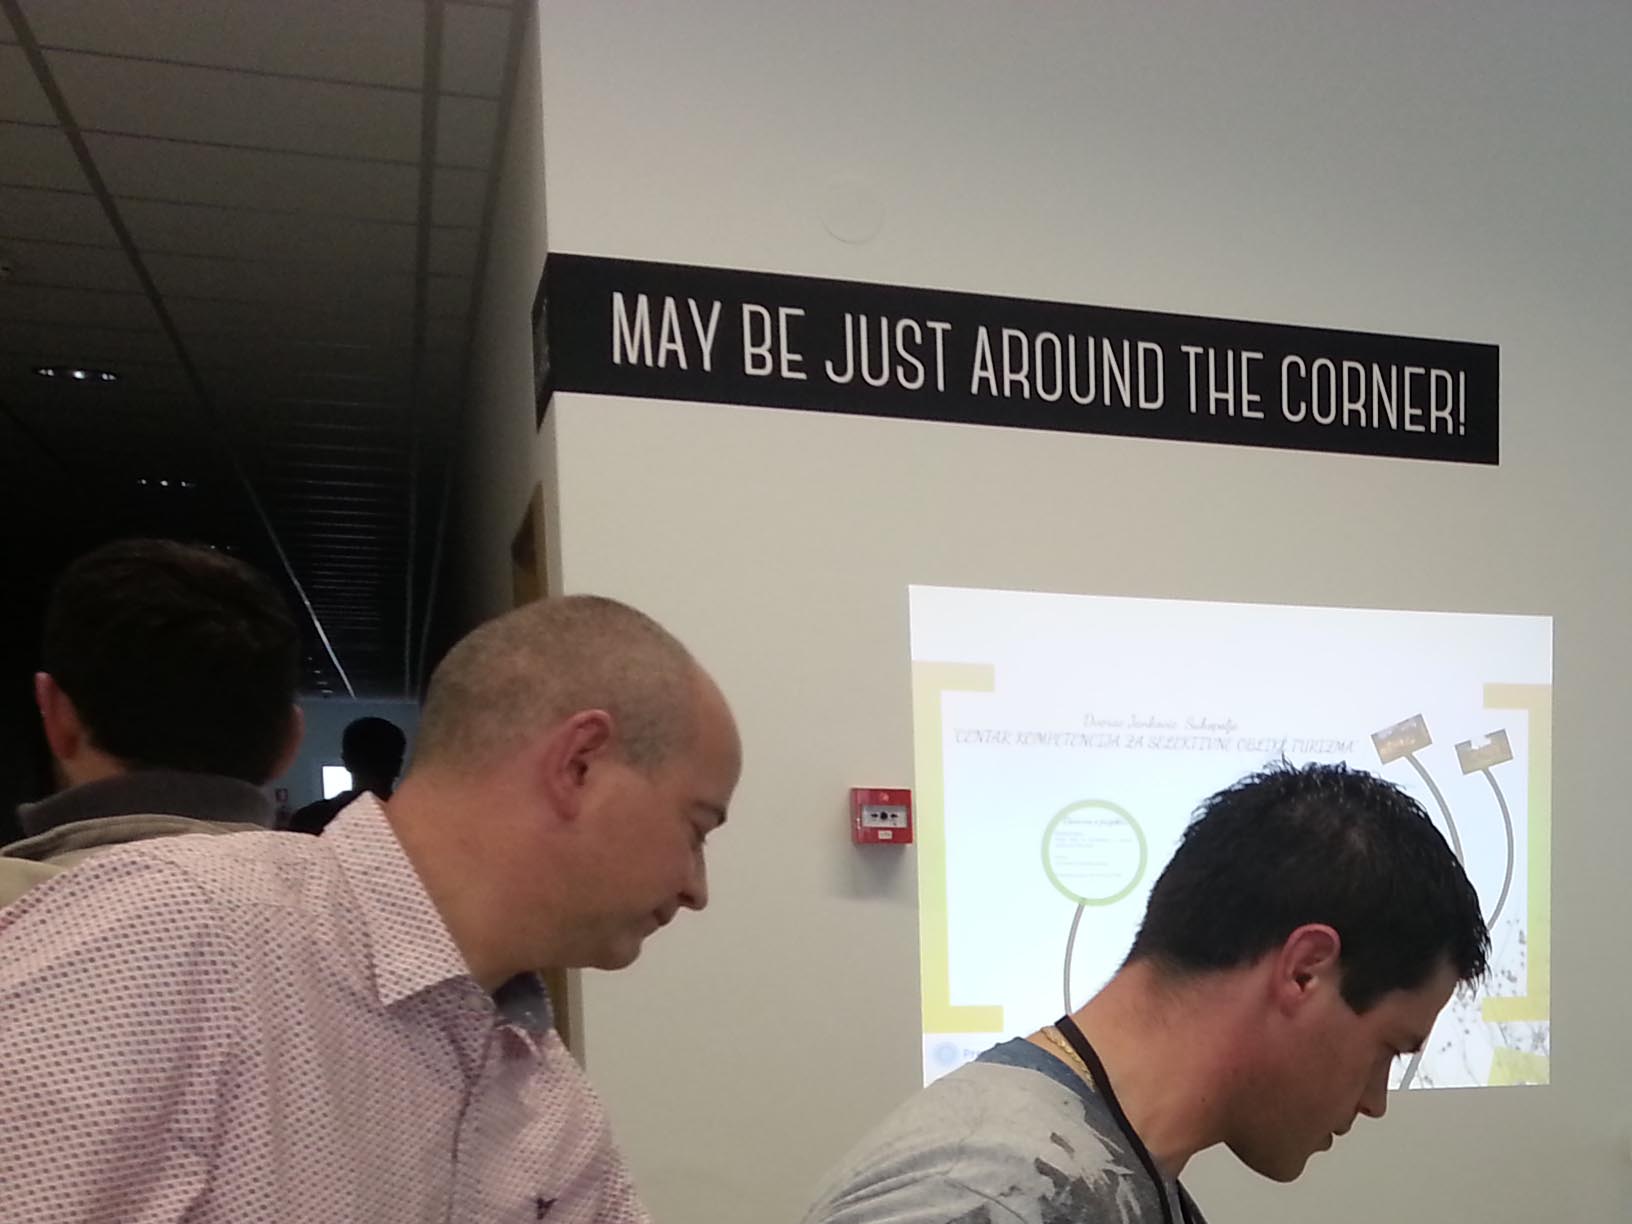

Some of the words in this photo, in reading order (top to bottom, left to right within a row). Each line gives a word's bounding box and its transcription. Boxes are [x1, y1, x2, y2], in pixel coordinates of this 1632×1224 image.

[612, 291, 722, 372] MAY
[741, 302, 807, 380] BE
[825, 312, 952, 392] JUST
[970, 325, 1164, 411] AROUND
[1180, 344, 1265, 419] THE
[1280, 354, 1467, 437] CORNER!
